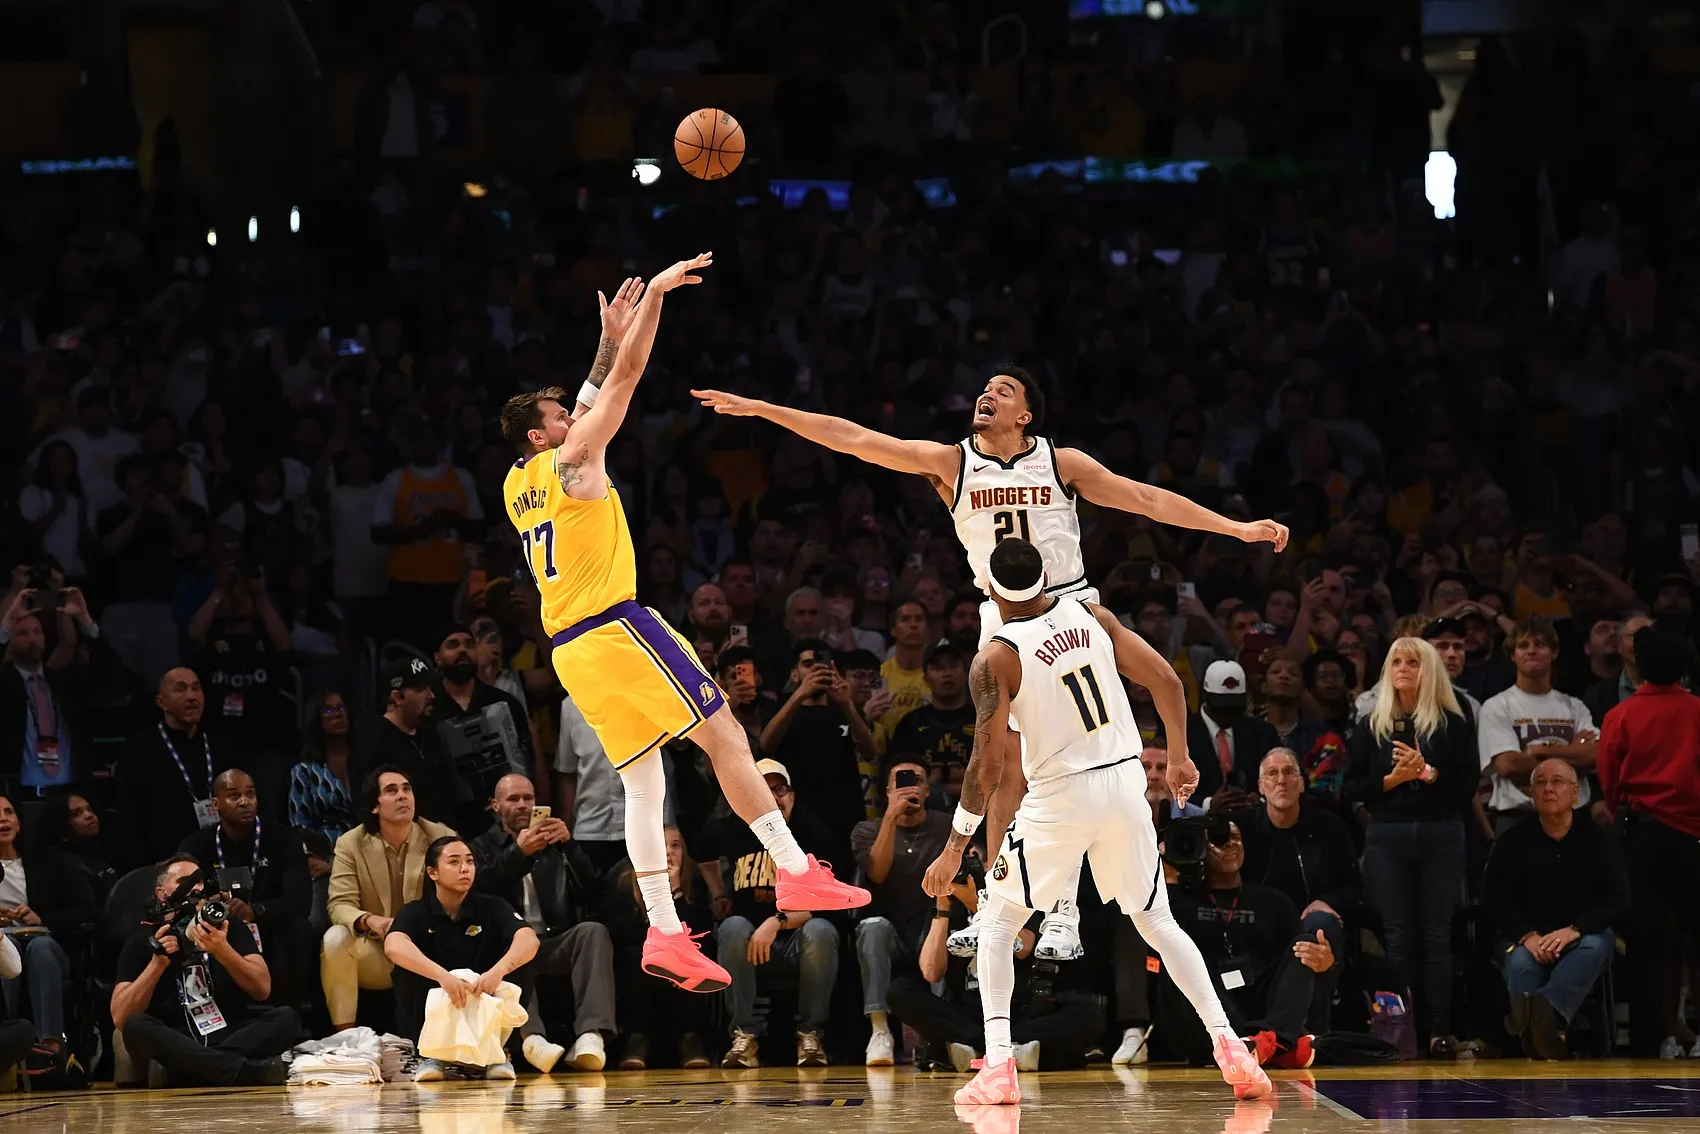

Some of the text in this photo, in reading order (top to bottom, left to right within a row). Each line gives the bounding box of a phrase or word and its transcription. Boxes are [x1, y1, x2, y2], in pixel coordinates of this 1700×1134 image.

[513, 486, 547, 518] DONČIĆ
[969, 486, 1052, 510] NUGGETS
[993, 509, 1030, 545] 21
[521, 520, 558, 583] 77
[1034, 628, 1090, 667] BROWN
[1060, 663, 1110, 733] 11
